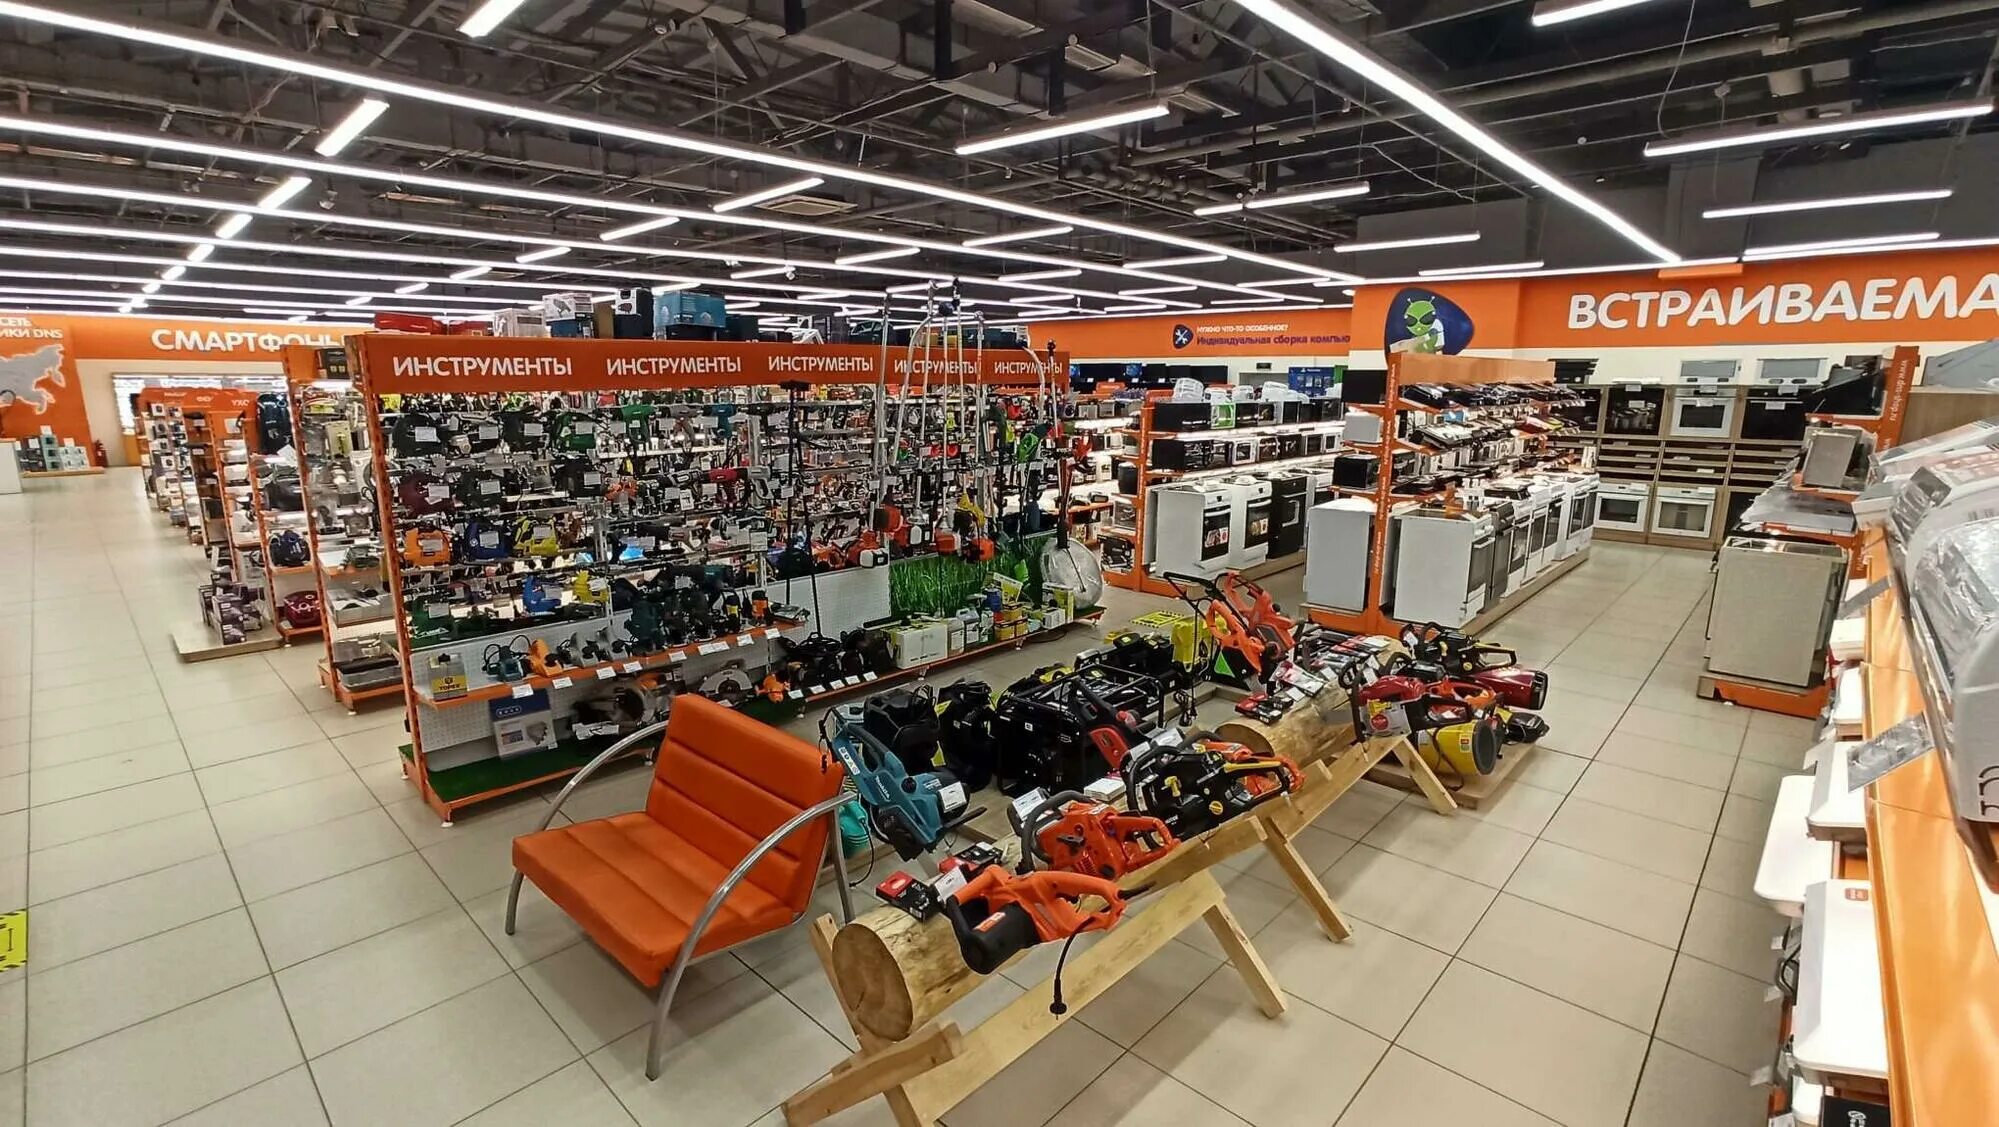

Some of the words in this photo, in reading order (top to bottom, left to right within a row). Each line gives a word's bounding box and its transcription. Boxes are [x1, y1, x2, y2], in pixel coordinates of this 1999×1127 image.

[1567, 273, 1999, 330] ВСТРАИВАЕМА
[0, 316, 33, 327] СЕТЬ
[1196, 325, 1221, 333] НУЖНО
[32, 328, 64, 339] DNS
[1196, 335, 1271, 347] Индивидуальная
[1273, 334, 1308, 347] сборка
[392, 356, 573, 377] ИНСТРУМЕНТЫ
[606, 356, 741, 376] ИНСТРУМЕНТЫ
[768, 356, 874, 373] ИНСТРУМЕНТЫ
[1889, 359, 1909, 421] www.dns-shop.ru
